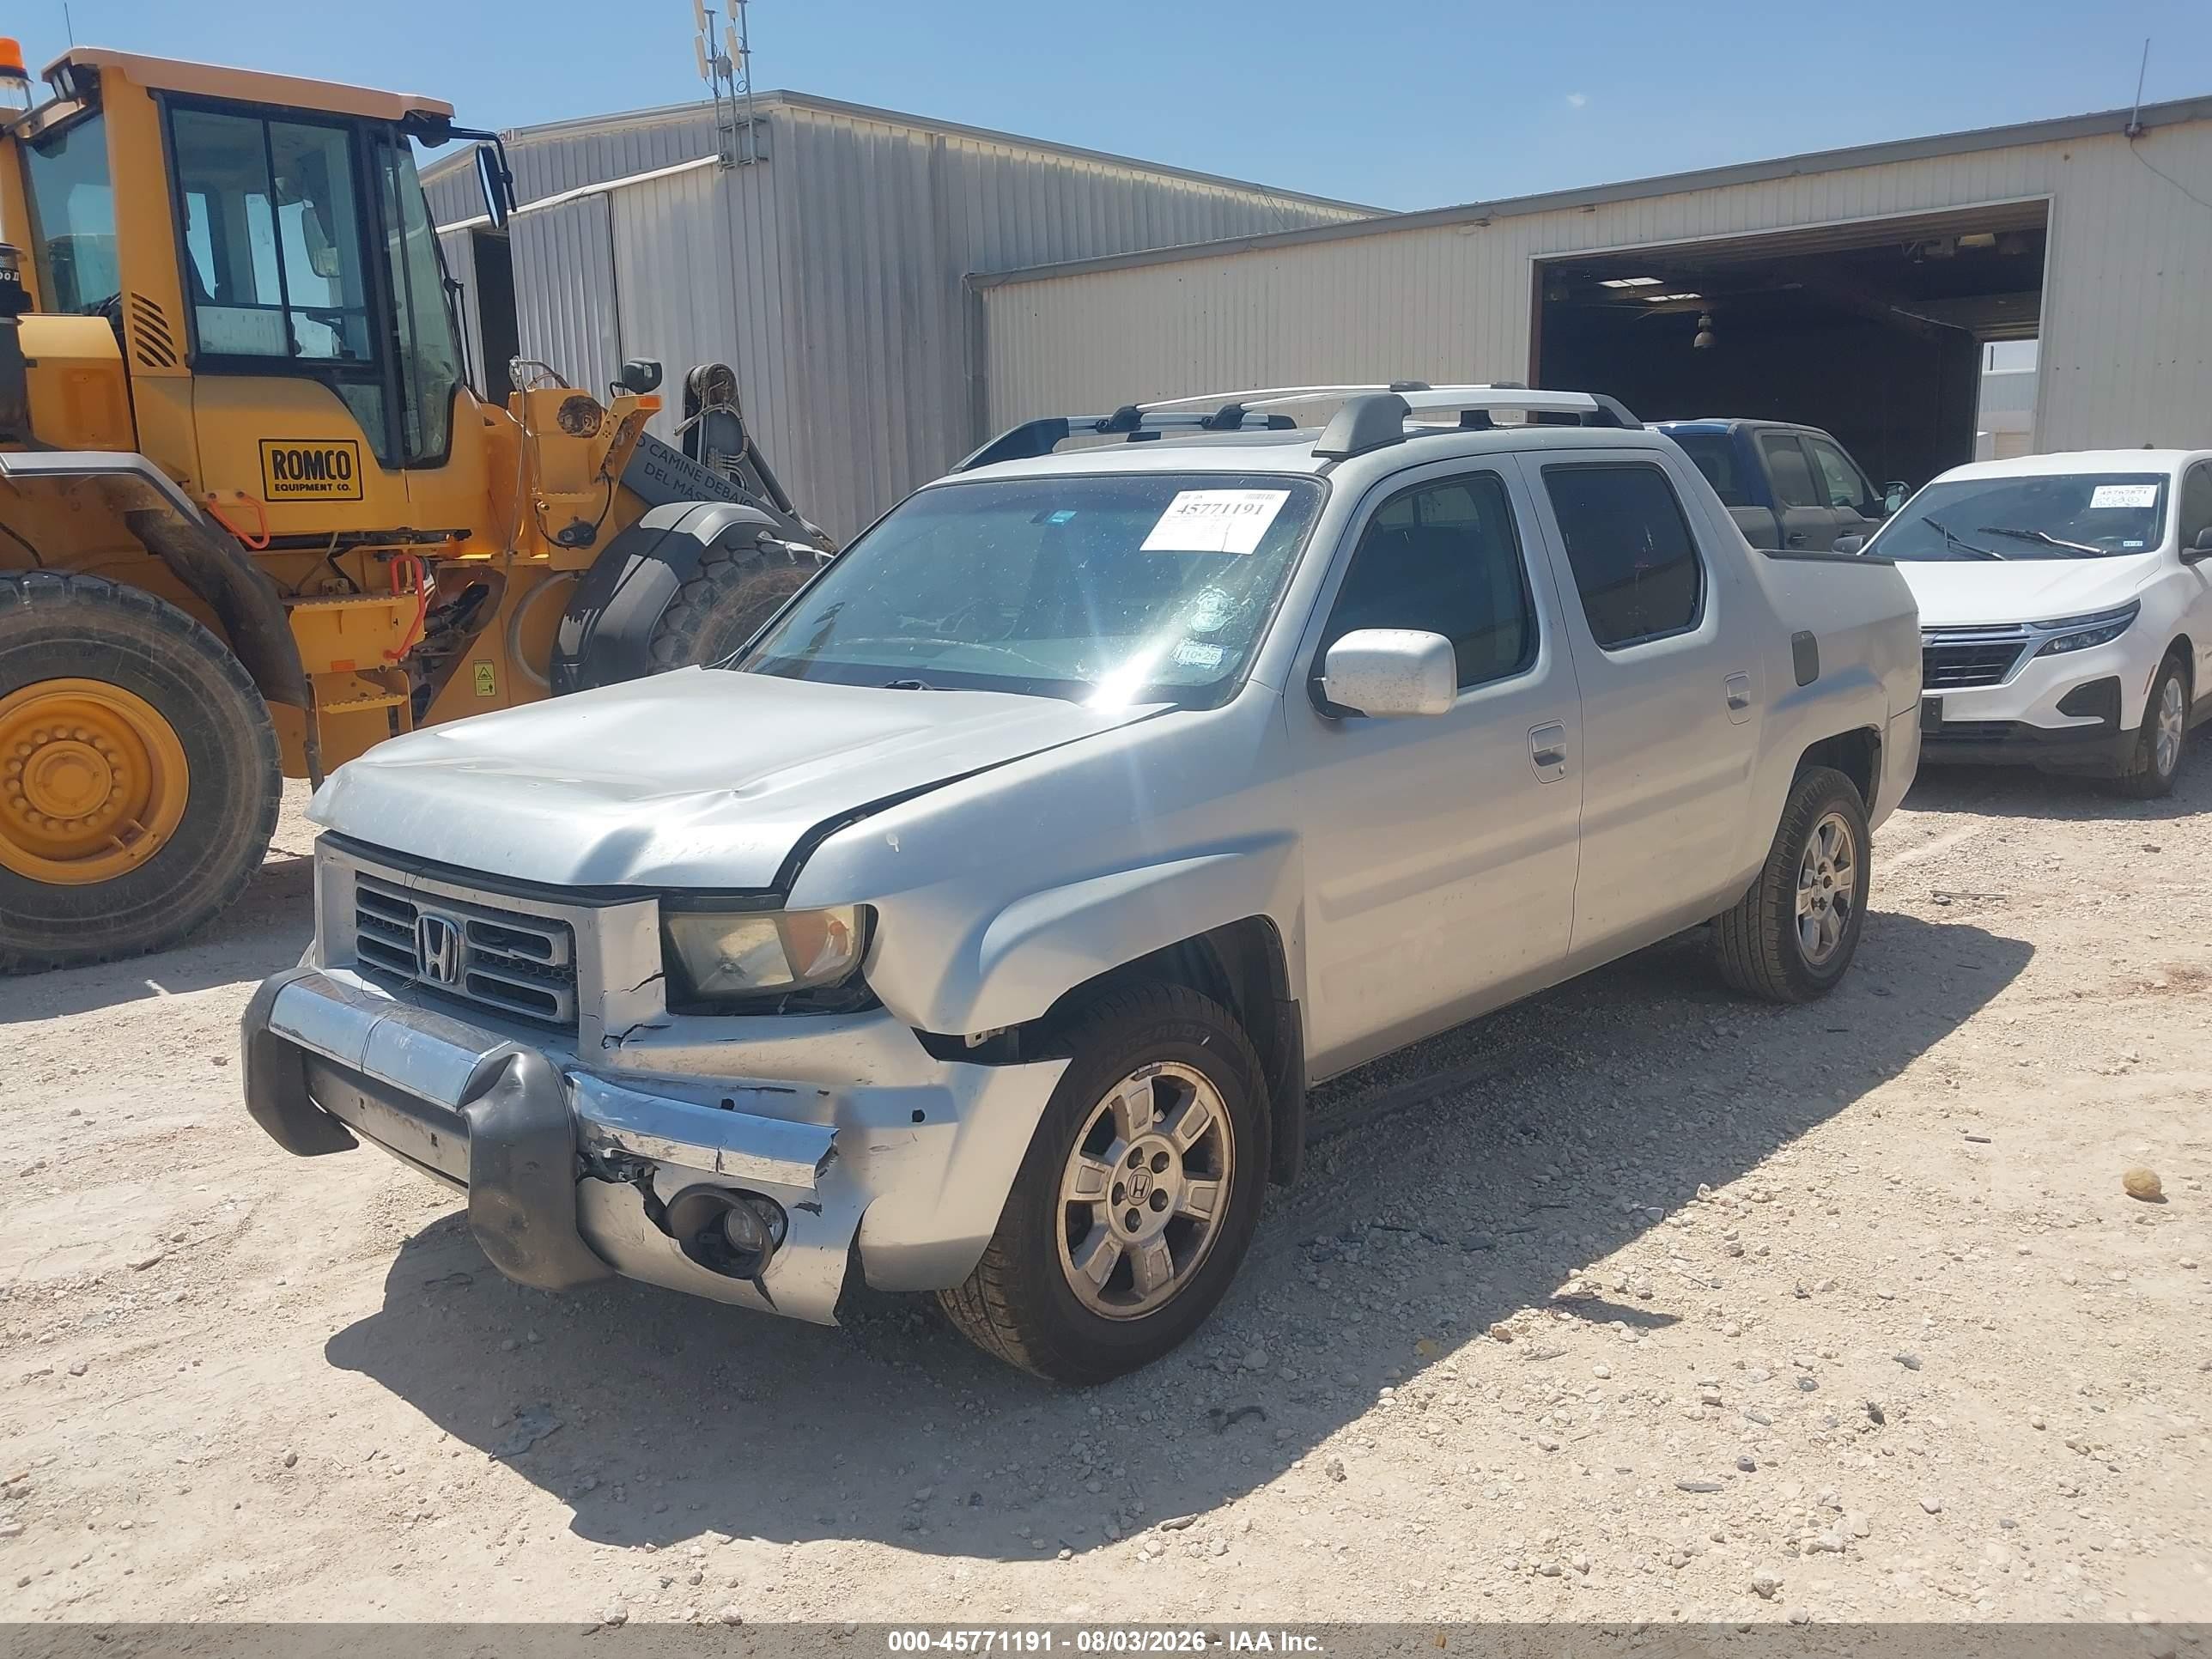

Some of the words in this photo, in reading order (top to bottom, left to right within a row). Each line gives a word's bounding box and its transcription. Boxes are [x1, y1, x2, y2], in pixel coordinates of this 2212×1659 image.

[271, 449, 351, 480] ROMCO
[644, 461, 670, 486] DEL
[648, 444, 703, 483] CAMINE
[274, 483, 333, 492] EQUIPMENT
[337, 483, 351, 492] CO.
[1176, 502, 1265, 515] 45771191
